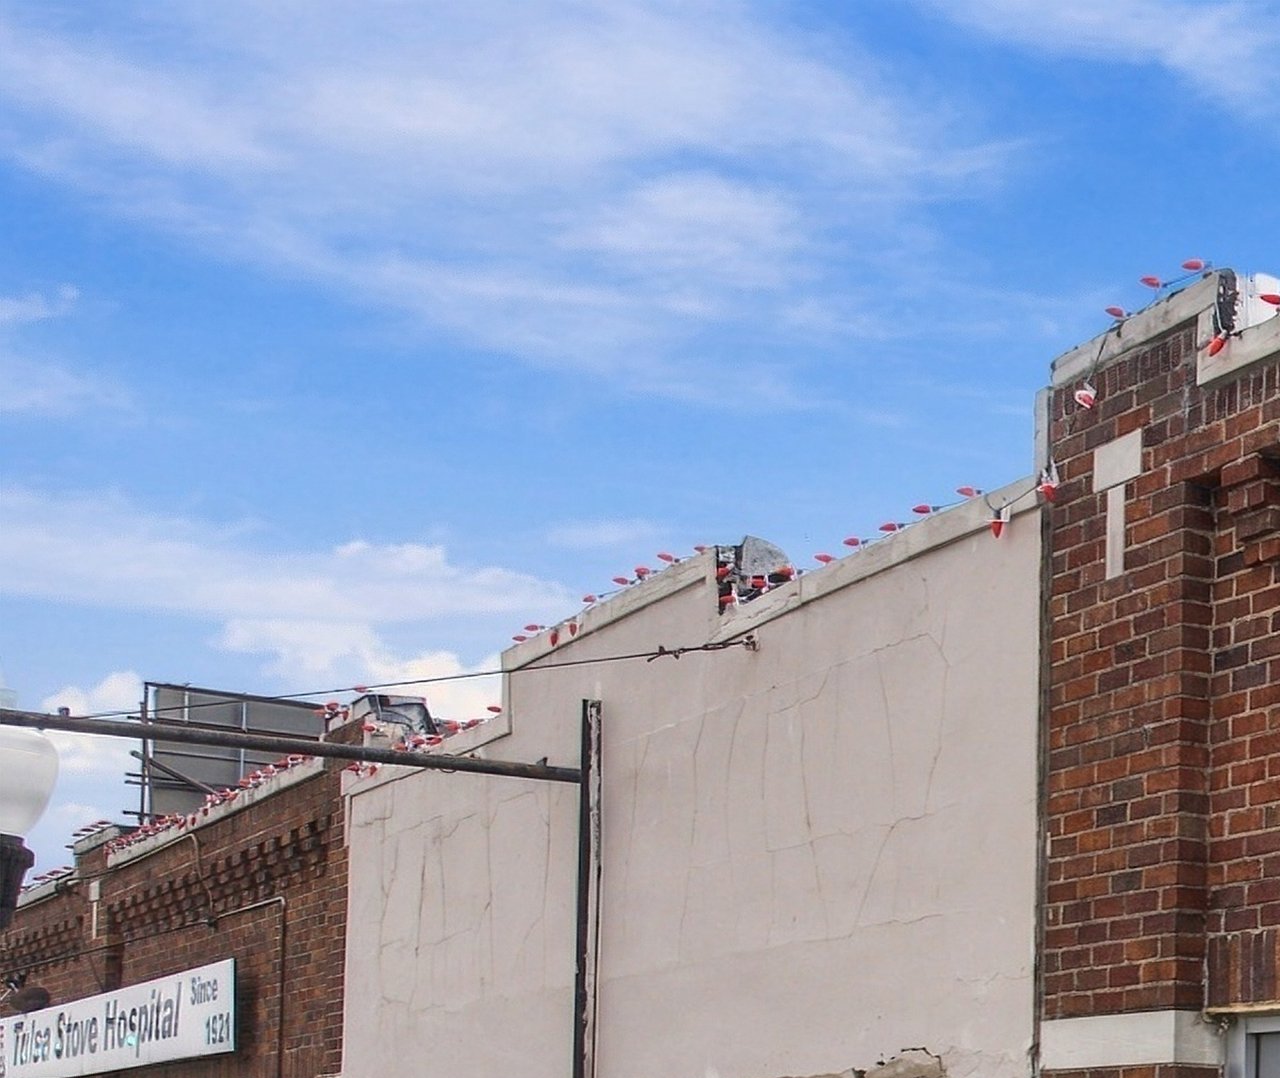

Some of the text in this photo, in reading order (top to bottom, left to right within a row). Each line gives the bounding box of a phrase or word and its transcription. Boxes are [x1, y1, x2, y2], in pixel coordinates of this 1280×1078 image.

[190, 976, 219, 1006] Since
[13, 1019, 51, 1067] Tulsa
[54, 1011, 98, 1060] Stove
[103, 982, 183, 1059] Hospital
[206, 1011, 231, 1045] 1921
